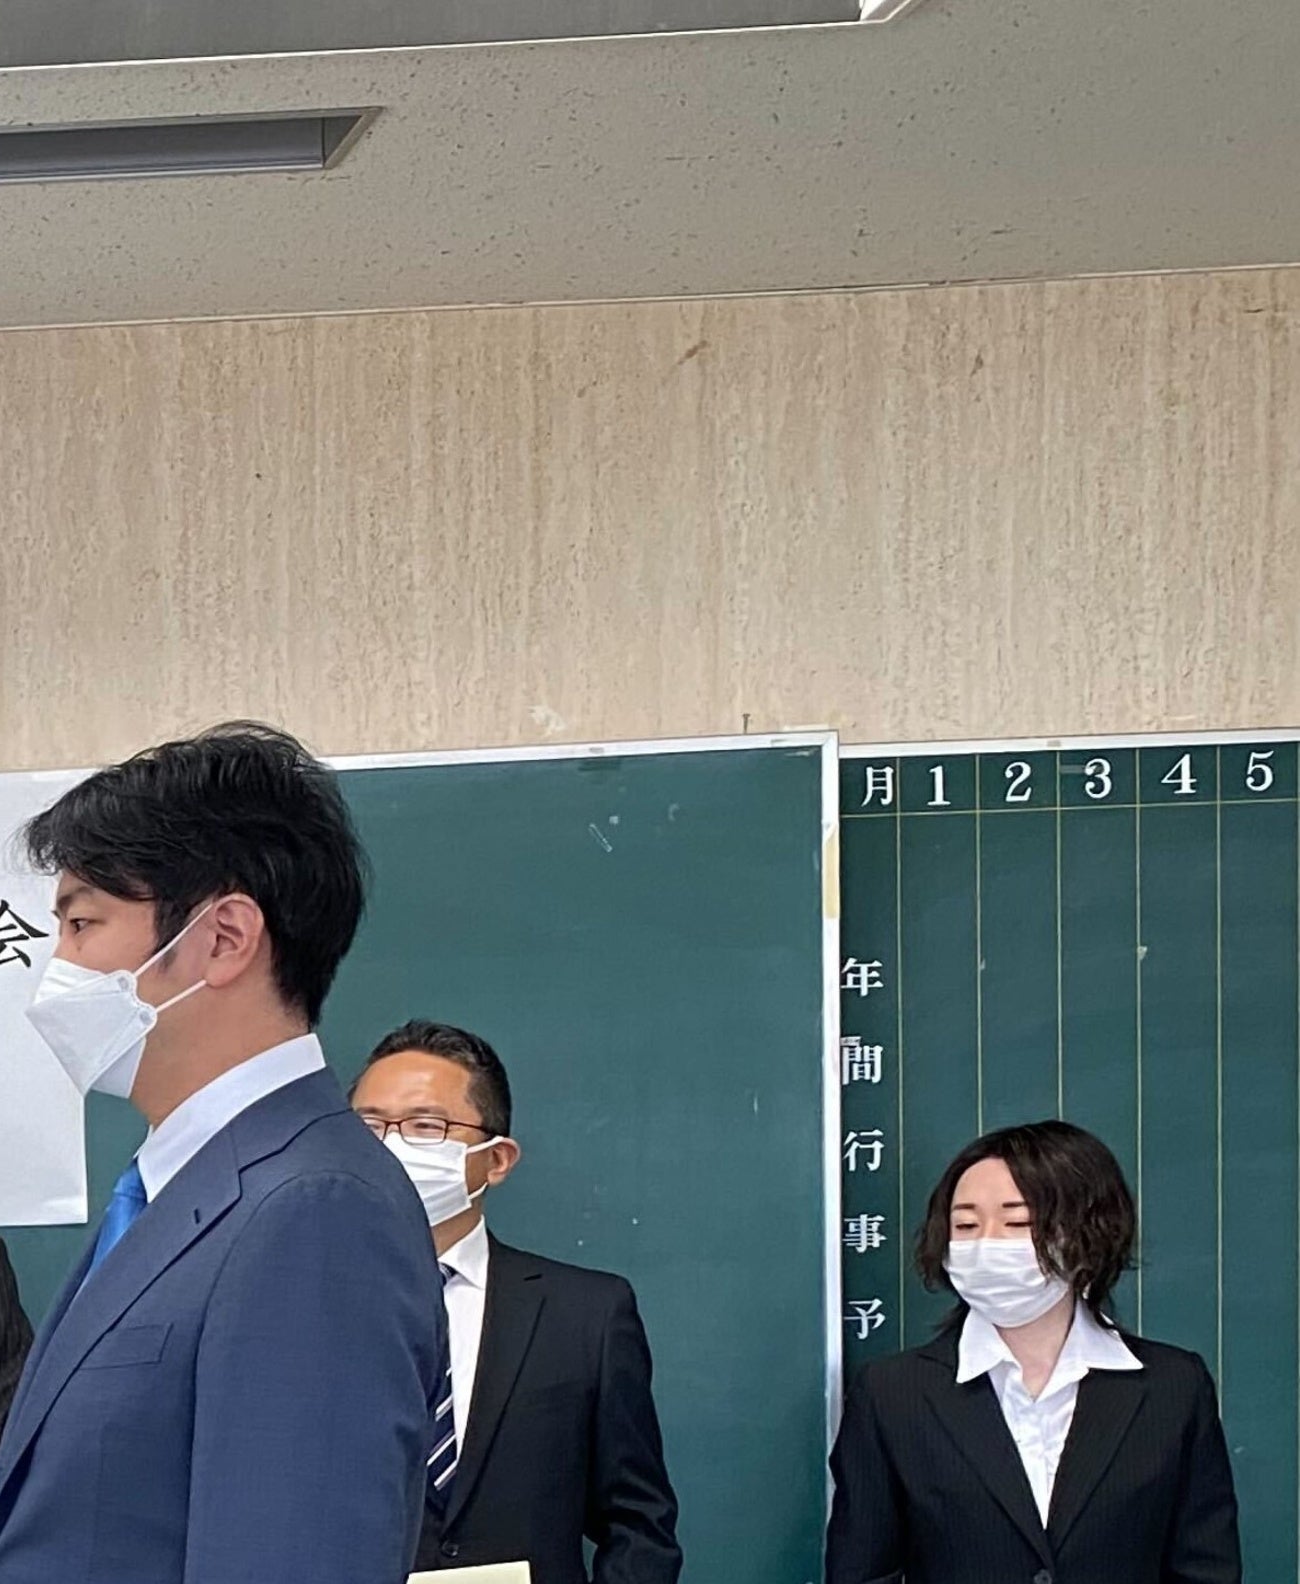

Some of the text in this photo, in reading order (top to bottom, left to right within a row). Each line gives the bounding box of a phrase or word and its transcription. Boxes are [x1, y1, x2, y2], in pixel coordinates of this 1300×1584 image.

[861, 750, 1274, 806] 月 1 2 3 4 5
